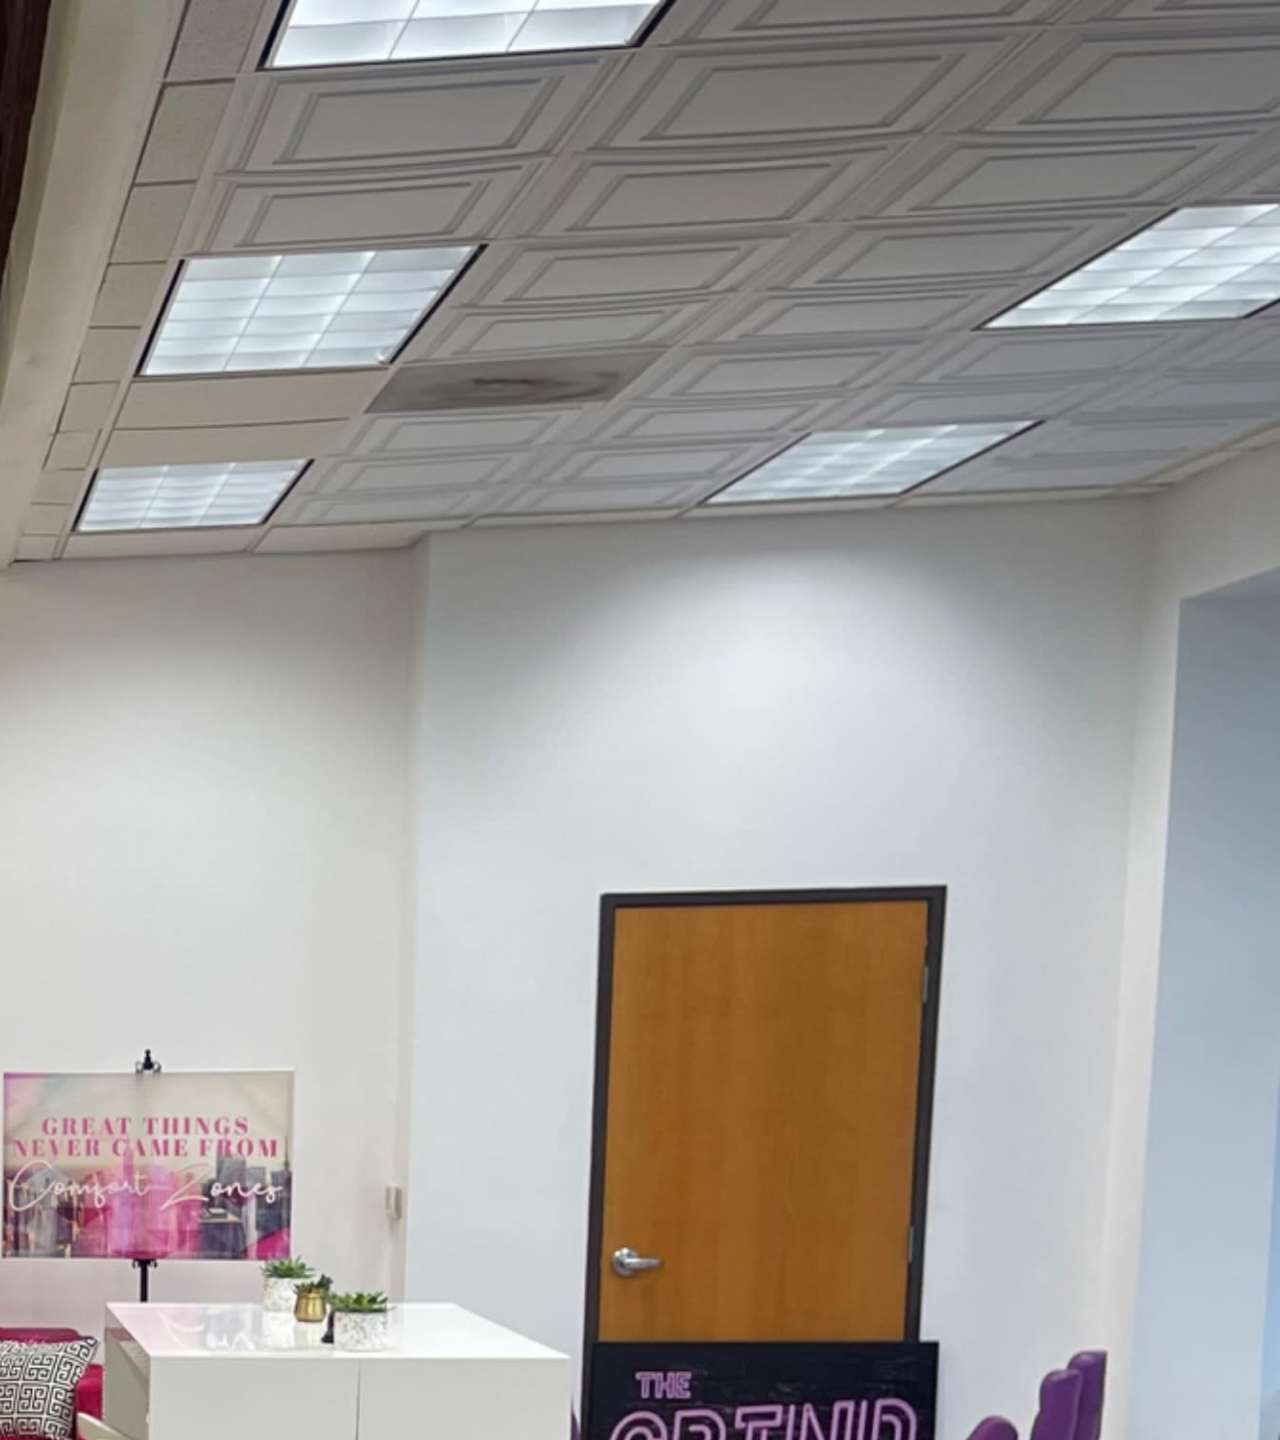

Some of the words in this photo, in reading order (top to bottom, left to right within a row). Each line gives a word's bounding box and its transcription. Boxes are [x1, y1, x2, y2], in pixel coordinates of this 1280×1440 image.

[41, 1116, 132, 1136] GREAT
[143, 1116, 249, 1136] THINGS
[14, 1138, 100, 1157] NEVER
[111, 1138, 188, 1157] CAME
[199, 1138, 278, 1158] FROM
[9, 1159, 173, 1209] Comfort
[159, 1163, 283, 1211] Zones
[636, 1371, 691, 1399] THE
